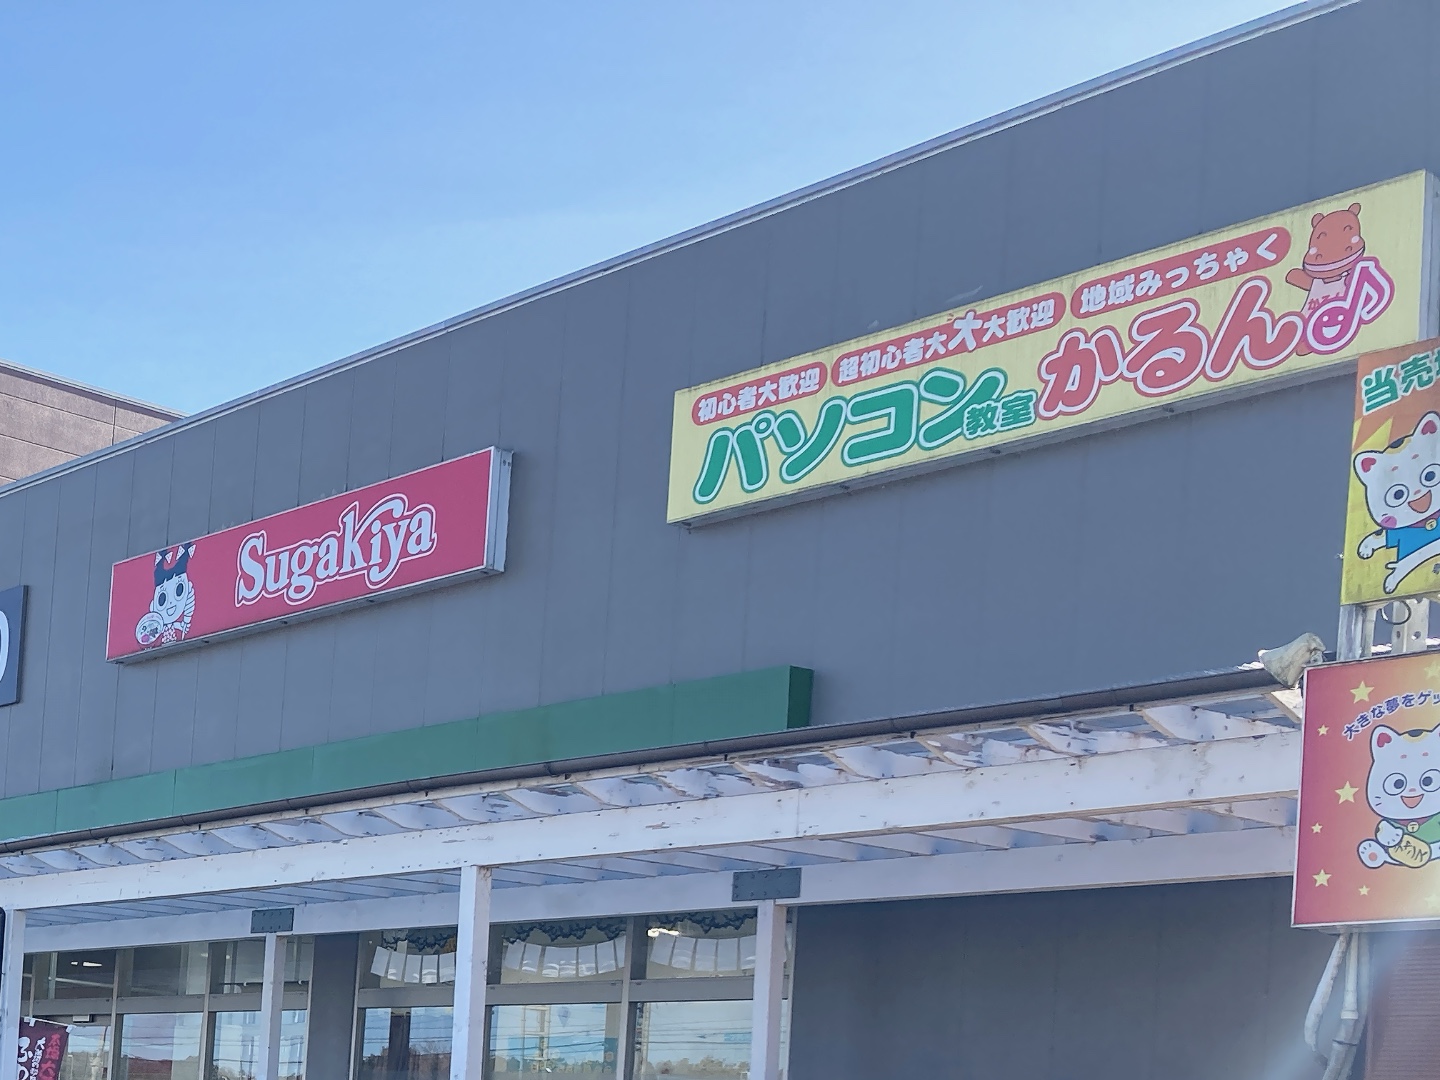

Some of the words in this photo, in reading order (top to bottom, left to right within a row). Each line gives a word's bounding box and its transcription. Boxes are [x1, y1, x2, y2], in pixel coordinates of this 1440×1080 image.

[1079, 232, 1278, 313] 地域みっちゃく
[838, 299, 1055, 383] 超初心者大大大歓迎
[693, 367, 1008, 504] パソコン
[963, 390, 1037, 440] 教室
[1035, 276, 1304, 419] かるん
[697, 368, 821, 422] 初心者大歓迎
[237, 494, 436, 606] Sugakiya
